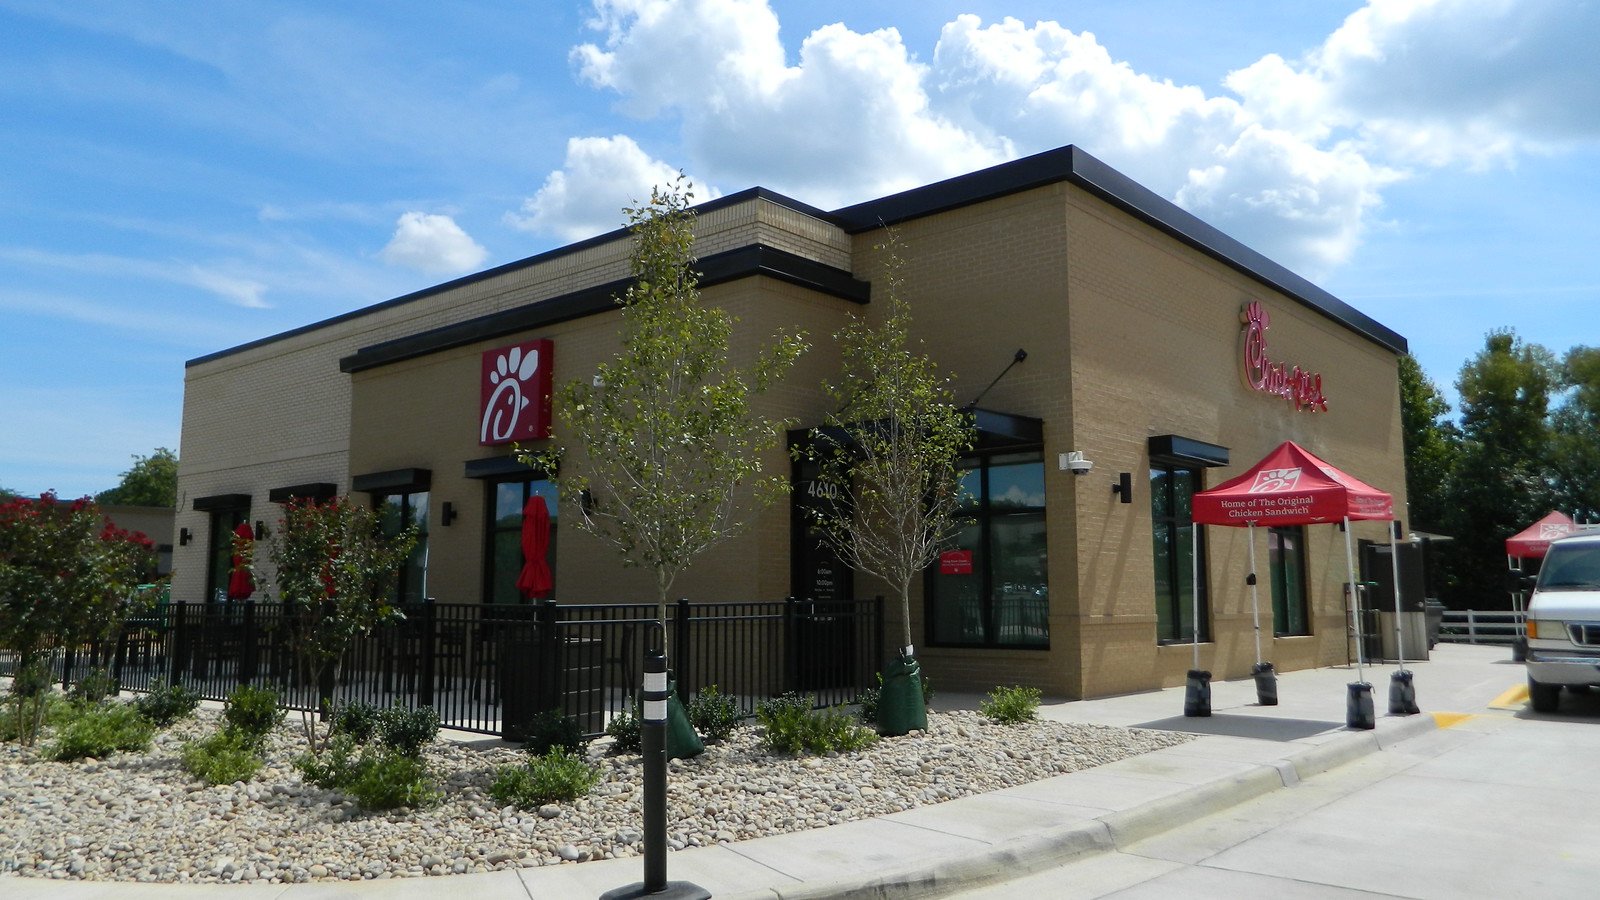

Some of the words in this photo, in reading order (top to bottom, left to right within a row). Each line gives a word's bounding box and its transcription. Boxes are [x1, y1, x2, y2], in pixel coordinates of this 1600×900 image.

[807, 480, 838, 500] 4610
[1221, 500, 1246, 508] Home
[1247, 498, 1258, 507] of
[1259, 498, 1276, 507] The
[1277, 495, 1314, 507] Original
[1228, 508, 1263, 518] Chicken
[1265, 505, 1310, 516] Sandwich
